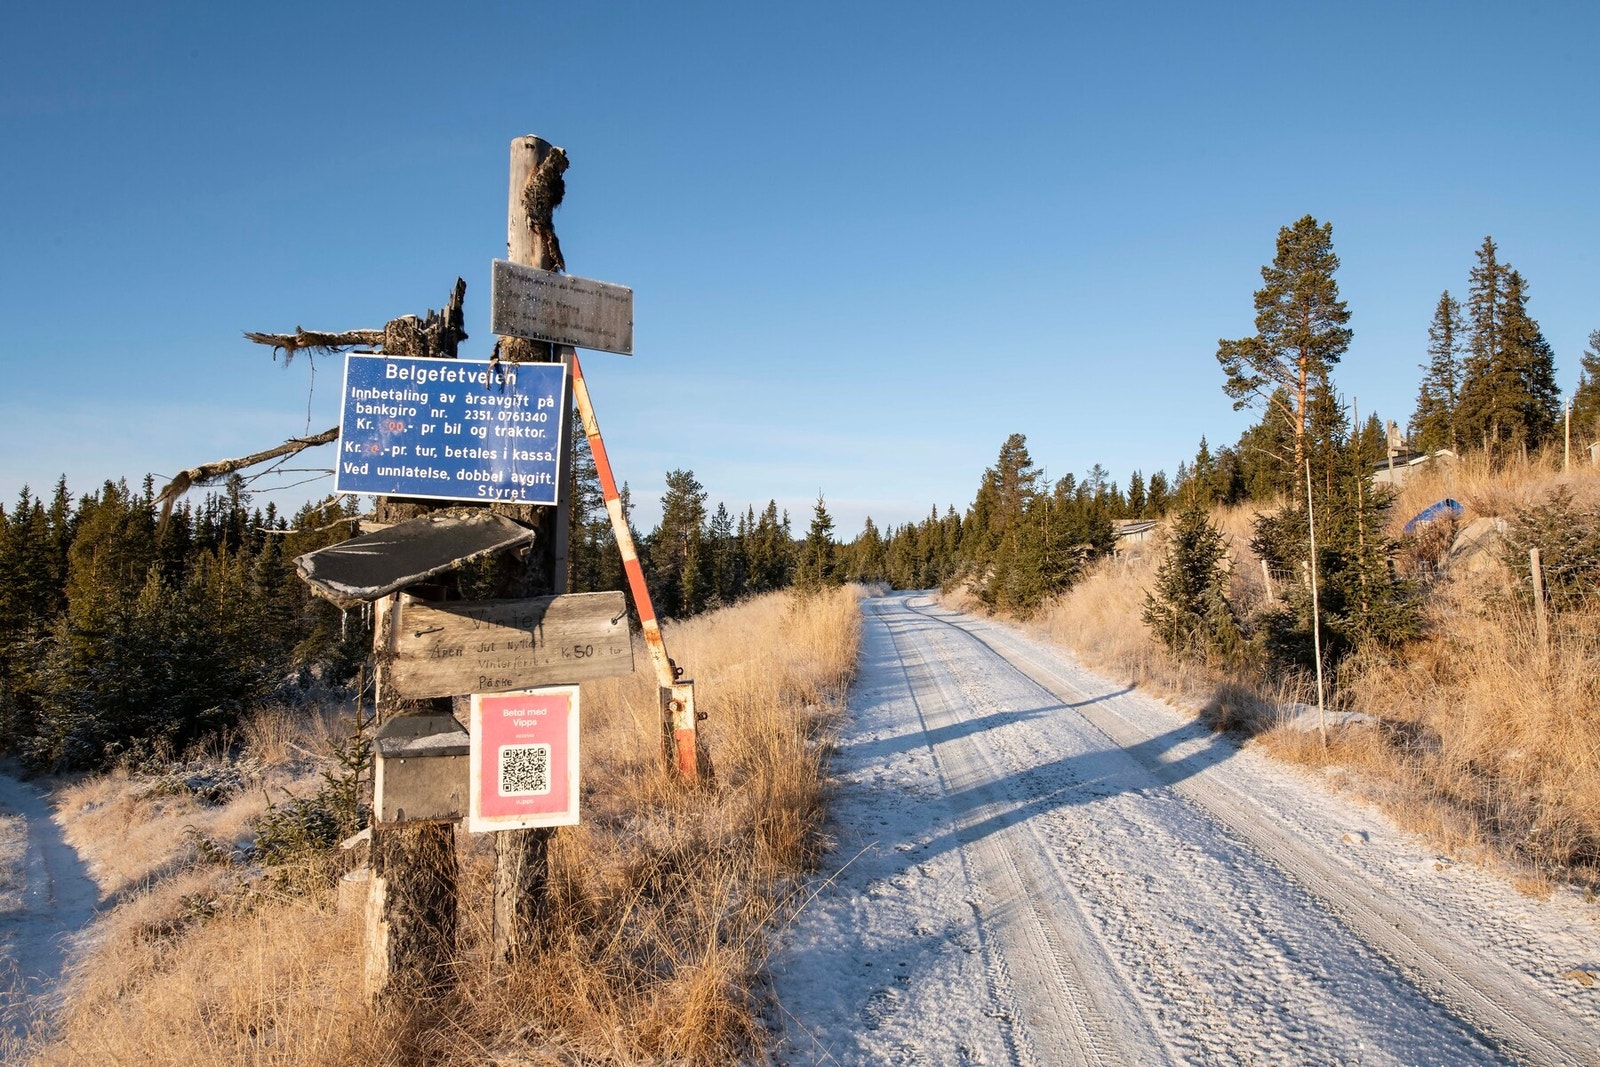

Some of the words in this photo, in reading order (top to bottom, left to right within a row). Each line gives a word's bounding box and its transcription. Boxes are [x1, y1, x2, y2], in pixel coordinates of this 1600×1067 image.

[385, 363, 517, 385] Belgefetveien
[351, 387, 428, 405] Innbetaling
[439, 393, 456, 403] av
[465, 392, 529, 409] årsavgift
[537, 395, 555, 410] på
[356, 402, 417, 418] bankgiro
[431, 408, 448, 418] nr.
[356, 417, 375, 430] Kr.
[421, 423, 436, 436] pr
[444, 422, 461, 435] bil
[470, 426, 487, 439] og
[494, 425, 546, 438] traktor.
[345, 440, 362, 453] Kr.
[415, 444, 438, 459] tur,
[444, 445, 498, 460] betales
[502, 447, 508, 460] i
[512, 448, 555, 462] kassa.
[343, 461, 369, 475] Ved
[377, 465, 451, 480] unnlatelse,
[456, 468, 503, 483] dobbel
[511, 472, 555, 486] avgift.
[477, 485, 526, 499] Styret
[430, 639, 463, 659] Åpen
[477, 642, 496, 653] Jul
[573, 644, 594, 659] 50
[479, 675, 513, 690] Påske
[503, 708, 526, 717] Betal
[527, 708, 547, 716] med
[513, 718, 538, 728] Vipps
